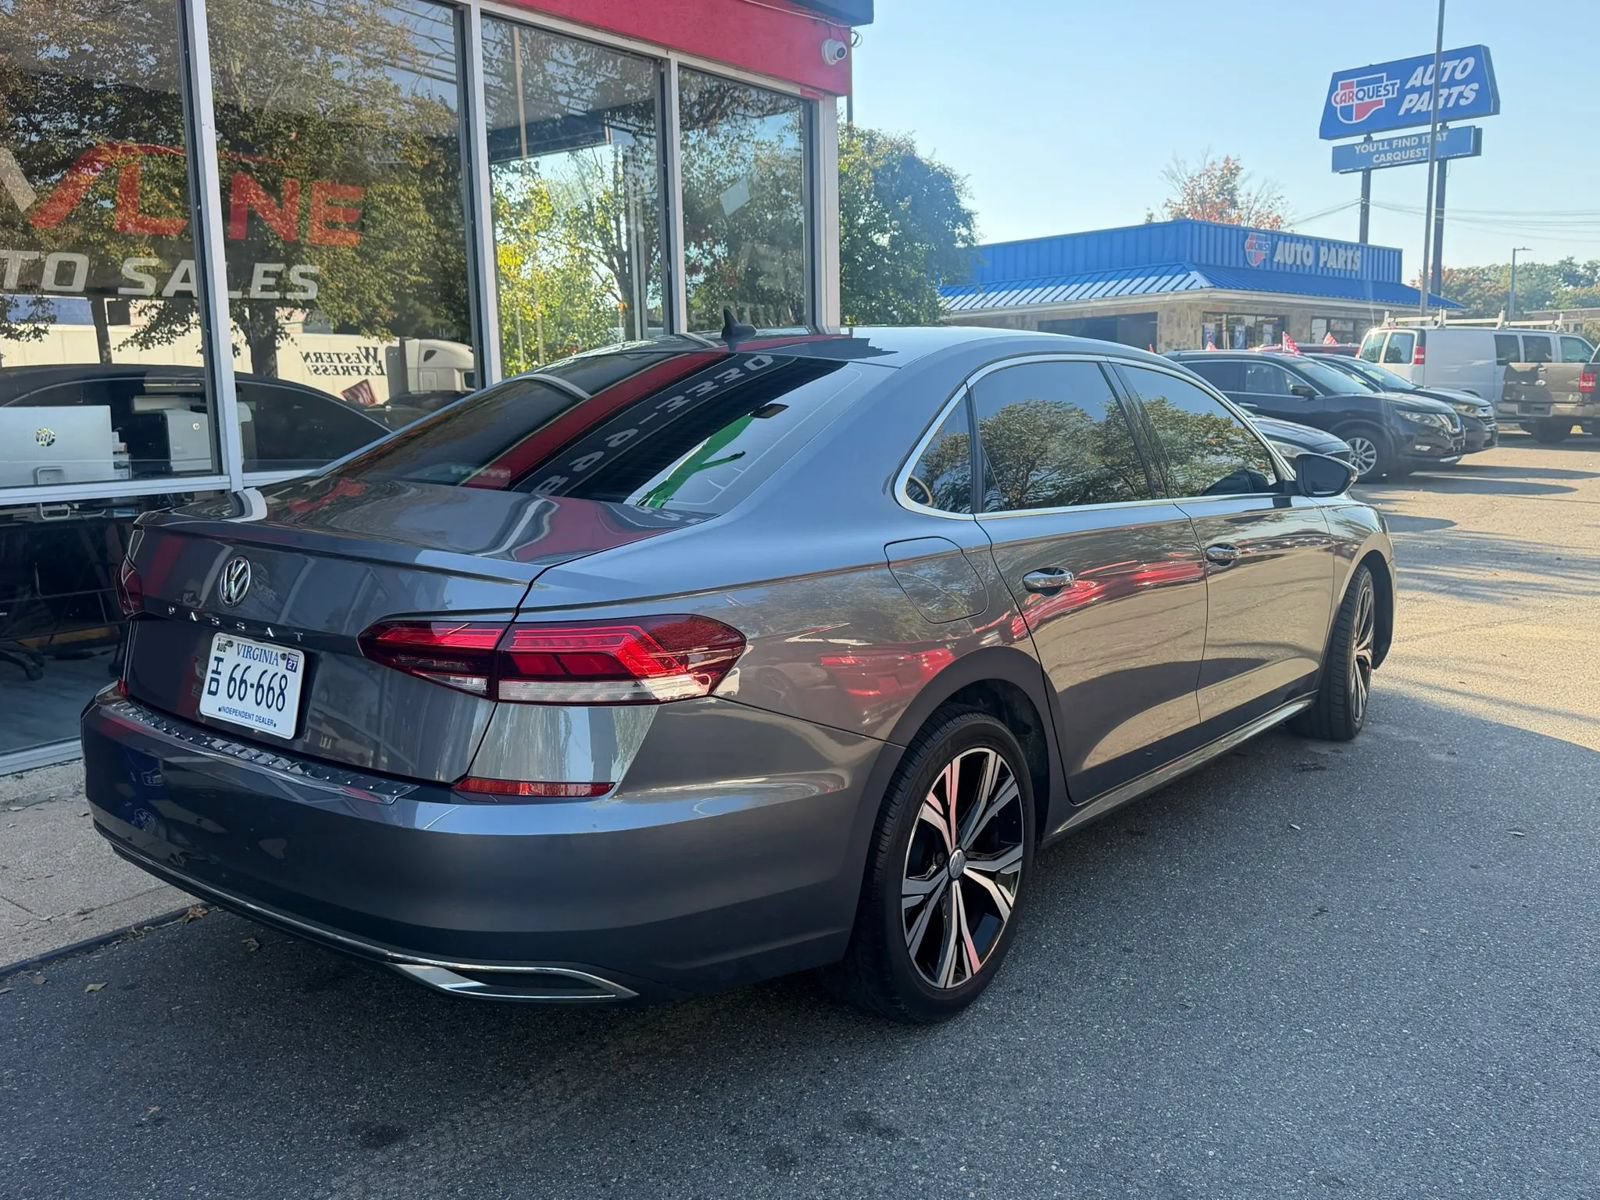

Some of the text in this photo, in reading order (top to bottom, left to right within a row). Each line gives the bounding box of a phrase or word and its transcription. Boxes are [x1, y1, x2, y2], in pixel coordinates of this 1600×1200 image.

[1405, 56, 1476, 89] AUTO
[1332, 81, 1399, 107] CARQUEST
[1398, 83, 1480, 116] PARTS
[1354, 141, 1389, 154] YOU'LL
[1393, 136, 1419, 149] FIND
[1372, 147, 1428, 163] CARQUEST
[1273, 240, 1314, 266] AUTO
[1319, 246, 1361, 272] PARTS
[237, 642, 279, 666] VIRGINIA
[286, 659, 297, 671] 27
[227, 663, 288, 712] 66-668
[221, 705, 274, 726] INDEPENDENT DEALER
